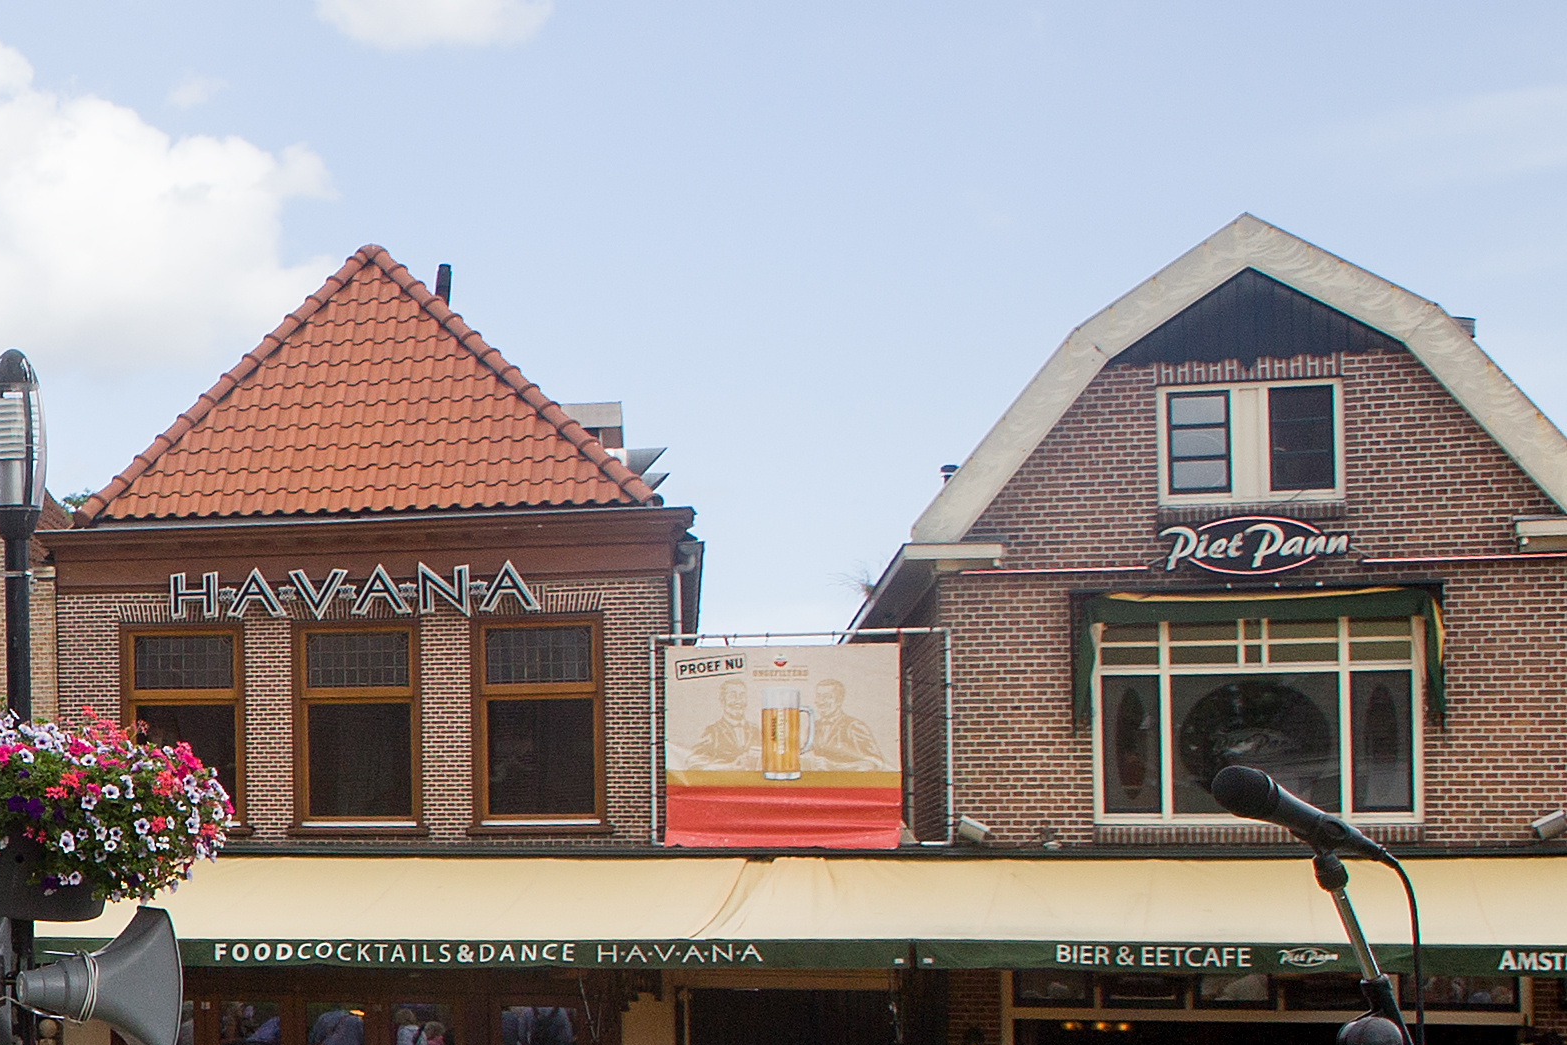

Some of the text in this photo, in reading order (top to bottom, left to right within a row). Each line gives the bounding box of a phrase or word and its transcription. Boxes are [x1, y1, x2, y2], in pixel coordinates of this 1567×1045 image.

[1158, 522, 1349, 571] Piet Pann
[679, 657, 743, 675] PROEF NU
[1055, 944, 1253, 968] BIER & EETCAFE
[1498, 950, 1567, 971] AMST
